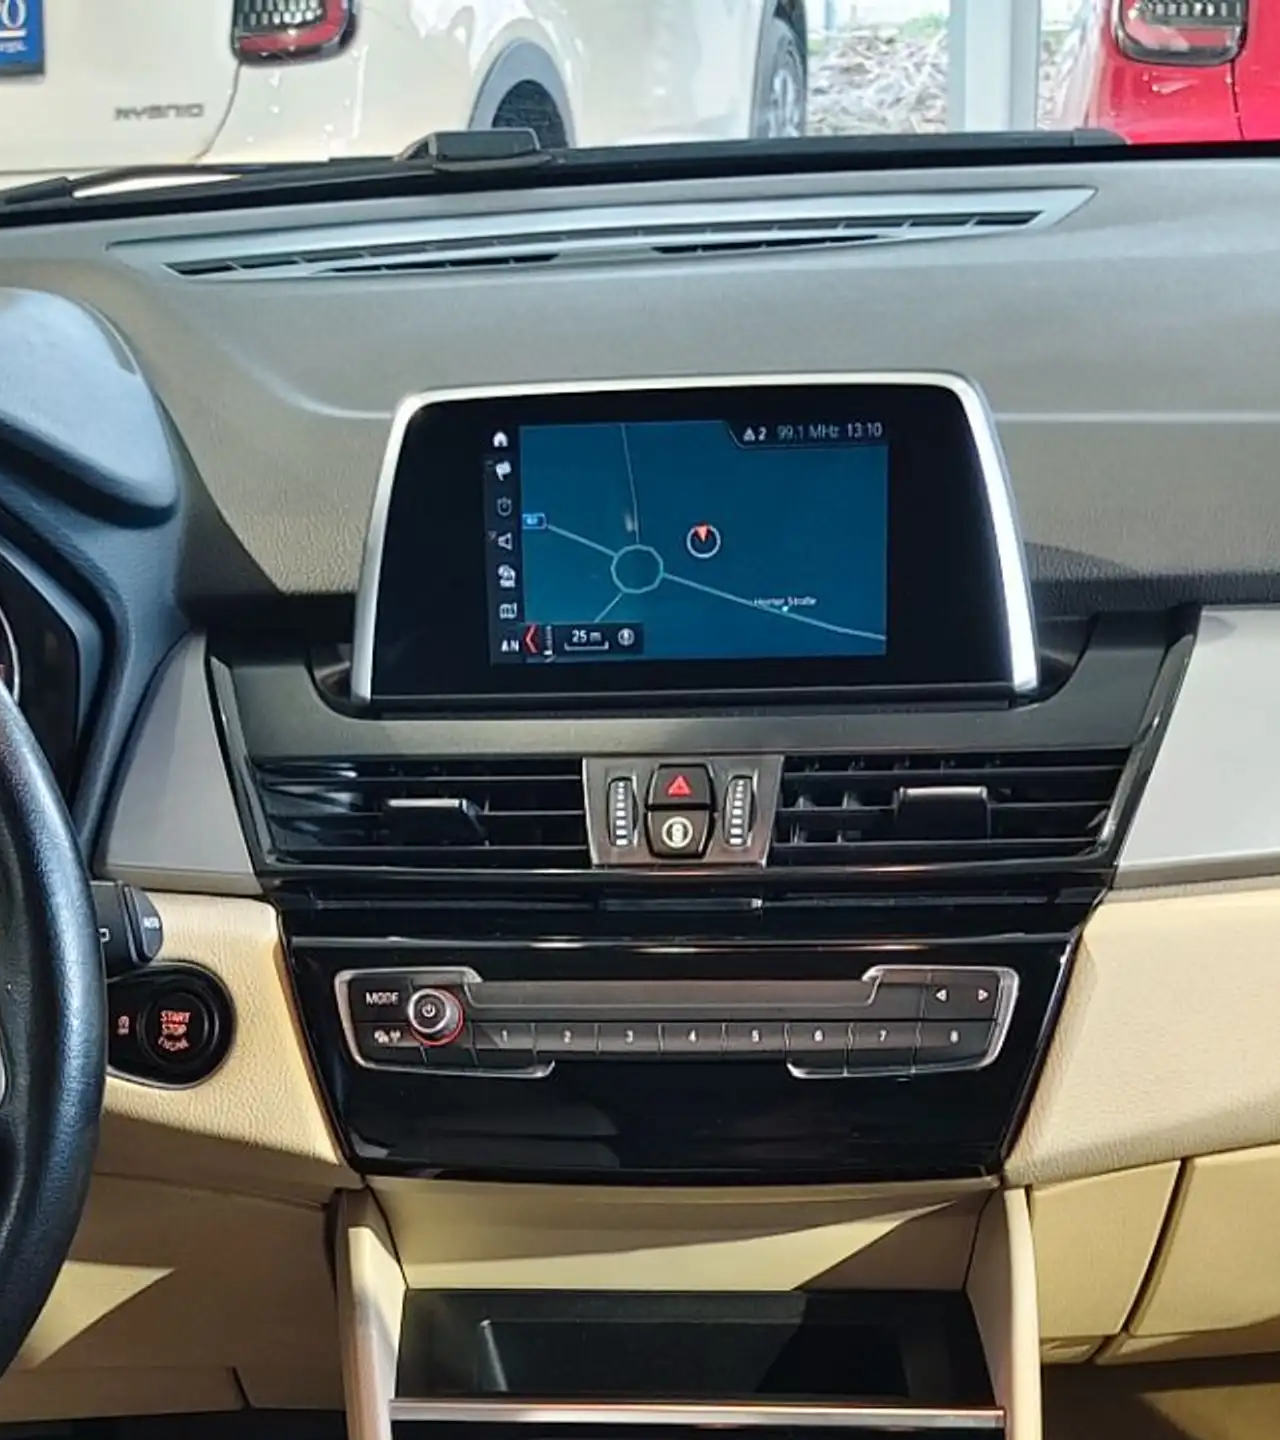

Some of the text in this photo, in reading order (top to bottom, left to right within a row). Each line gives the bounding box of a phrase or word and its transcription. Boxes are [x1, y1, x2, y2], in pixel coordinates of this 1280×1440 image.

[571, 629, 588, 643] 25
[365, 992, 400, 1006] MODE
[563, 1029, 572, 1043] 2
[626, 1029, 634, 1043] 3
[688, 1029, 698, 1043] 4
